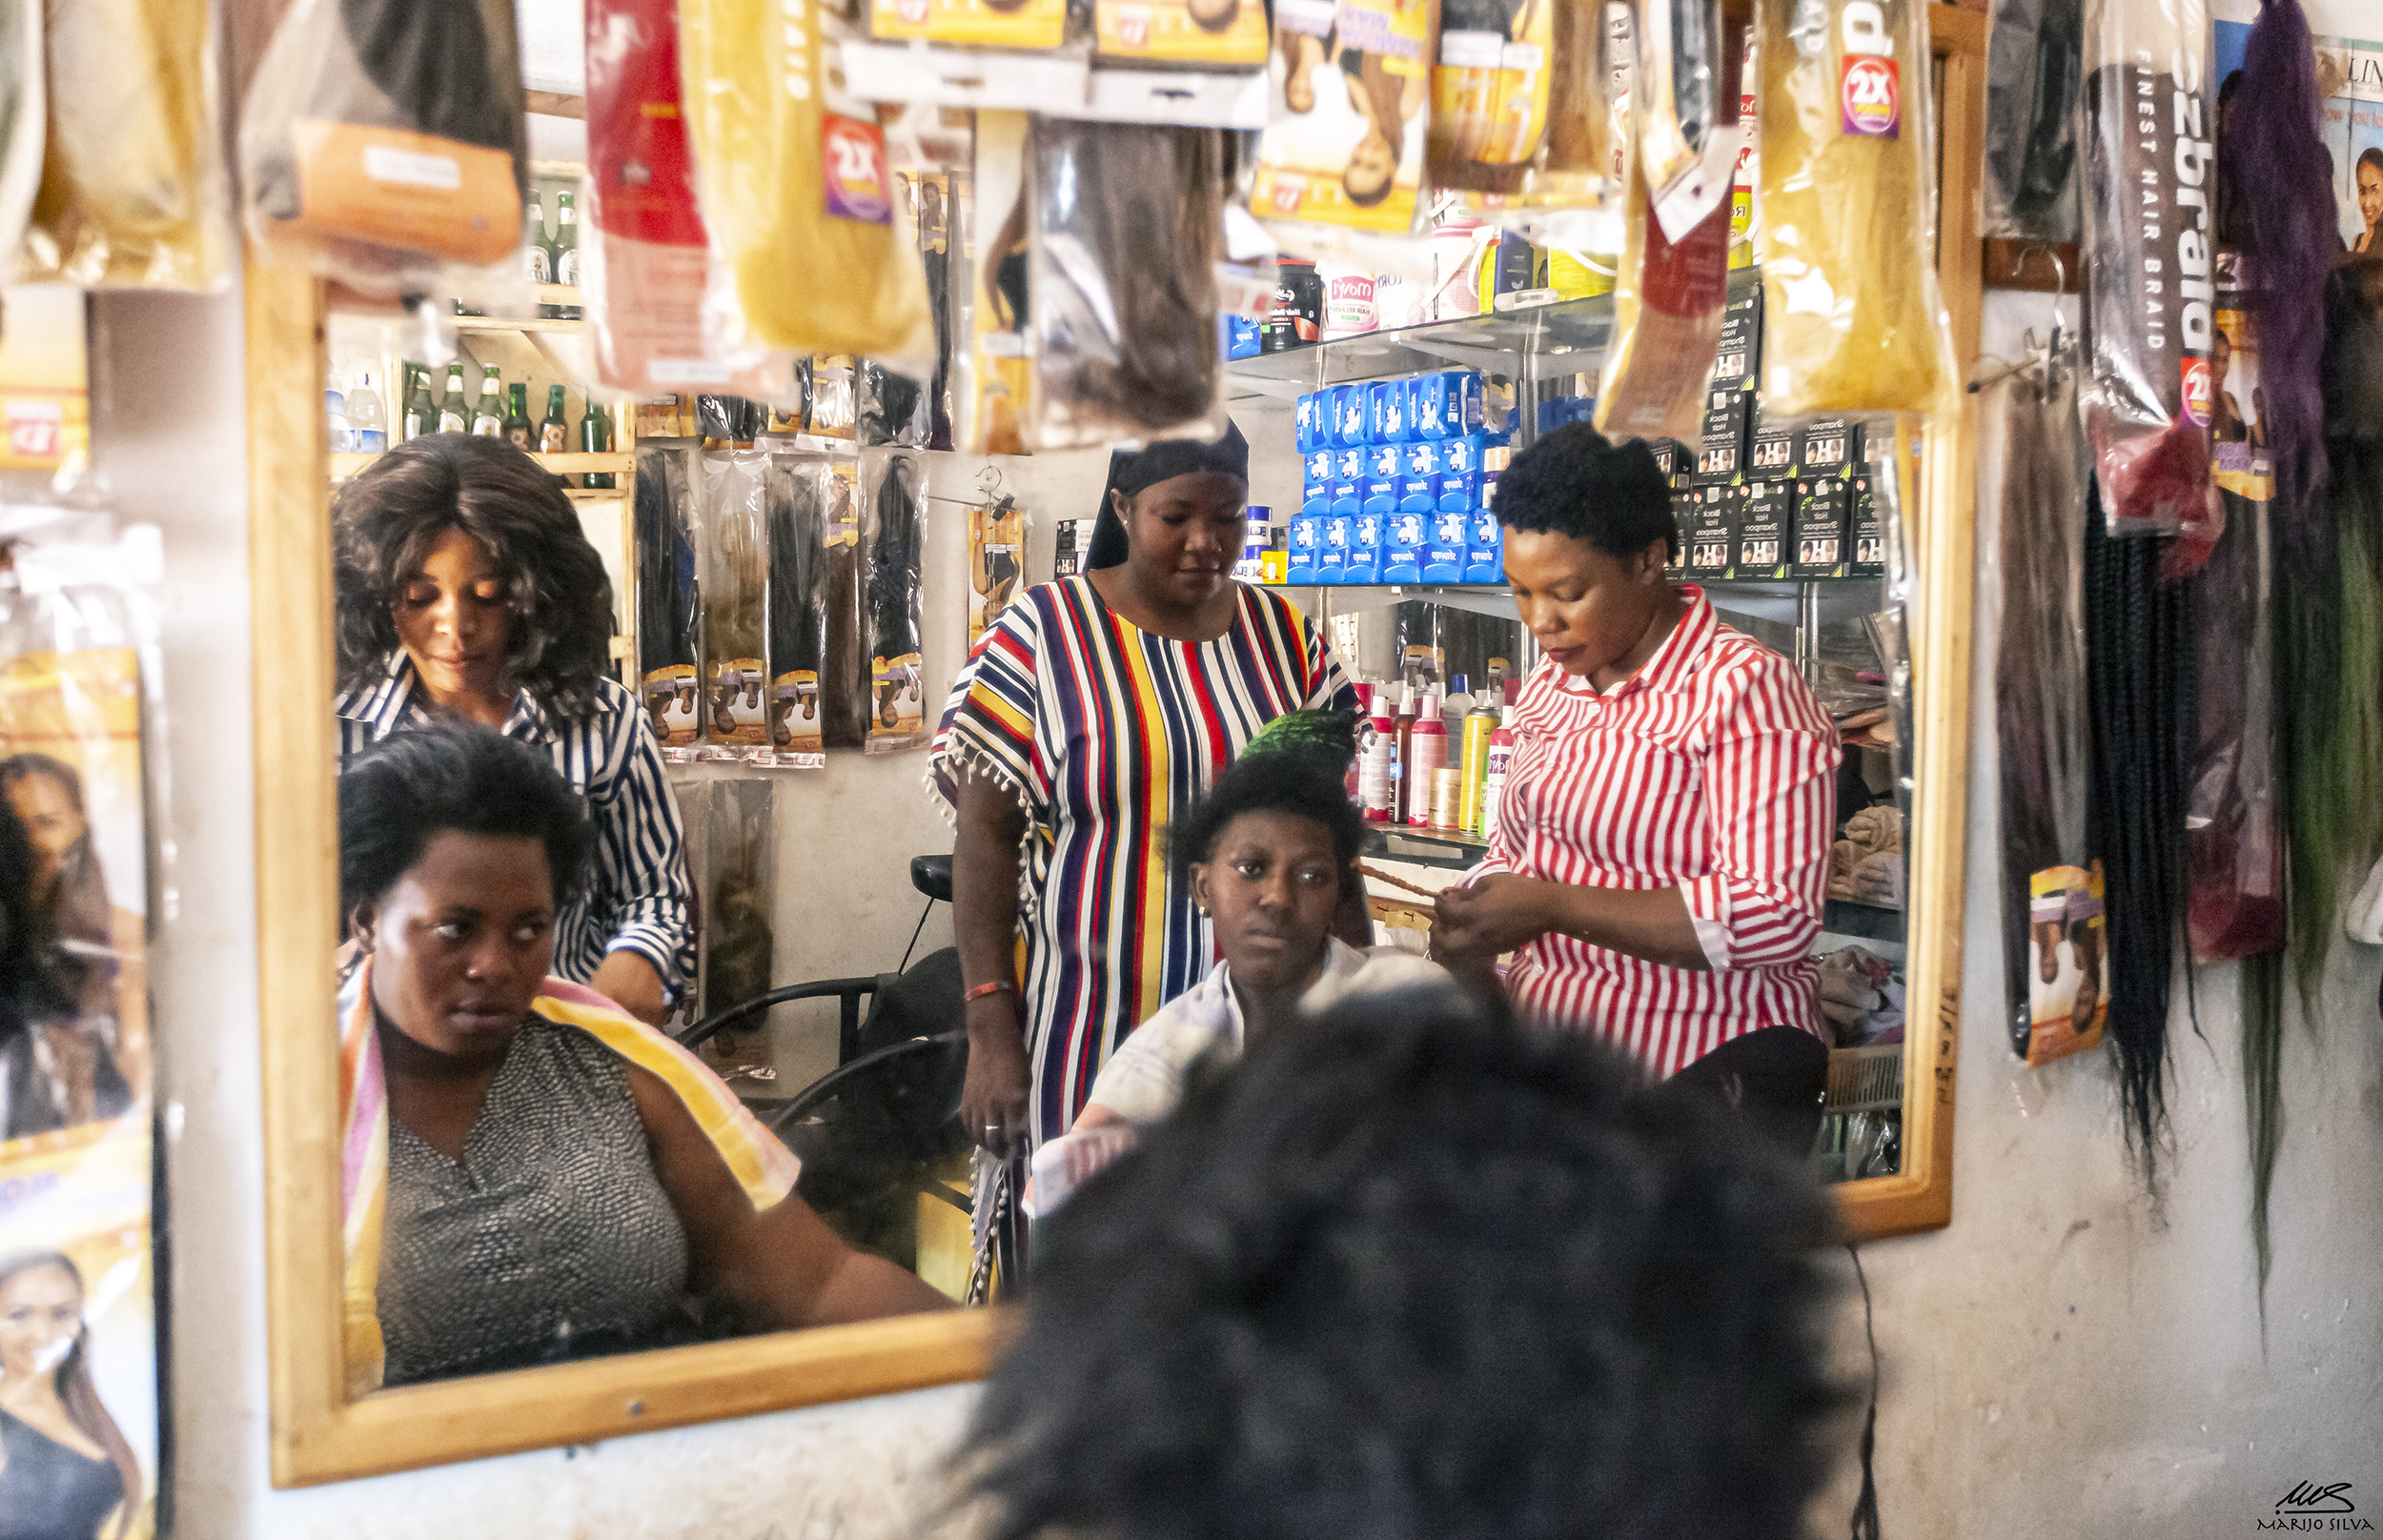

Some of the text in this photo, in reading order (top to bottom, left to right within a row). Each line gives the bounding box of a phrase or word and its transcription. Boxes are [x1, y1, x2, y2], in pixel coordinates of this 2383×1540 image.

[1849, 70, 1890, 104] 2X
[2136, 48, 2167, 350] FINEST HAIR BRAID
